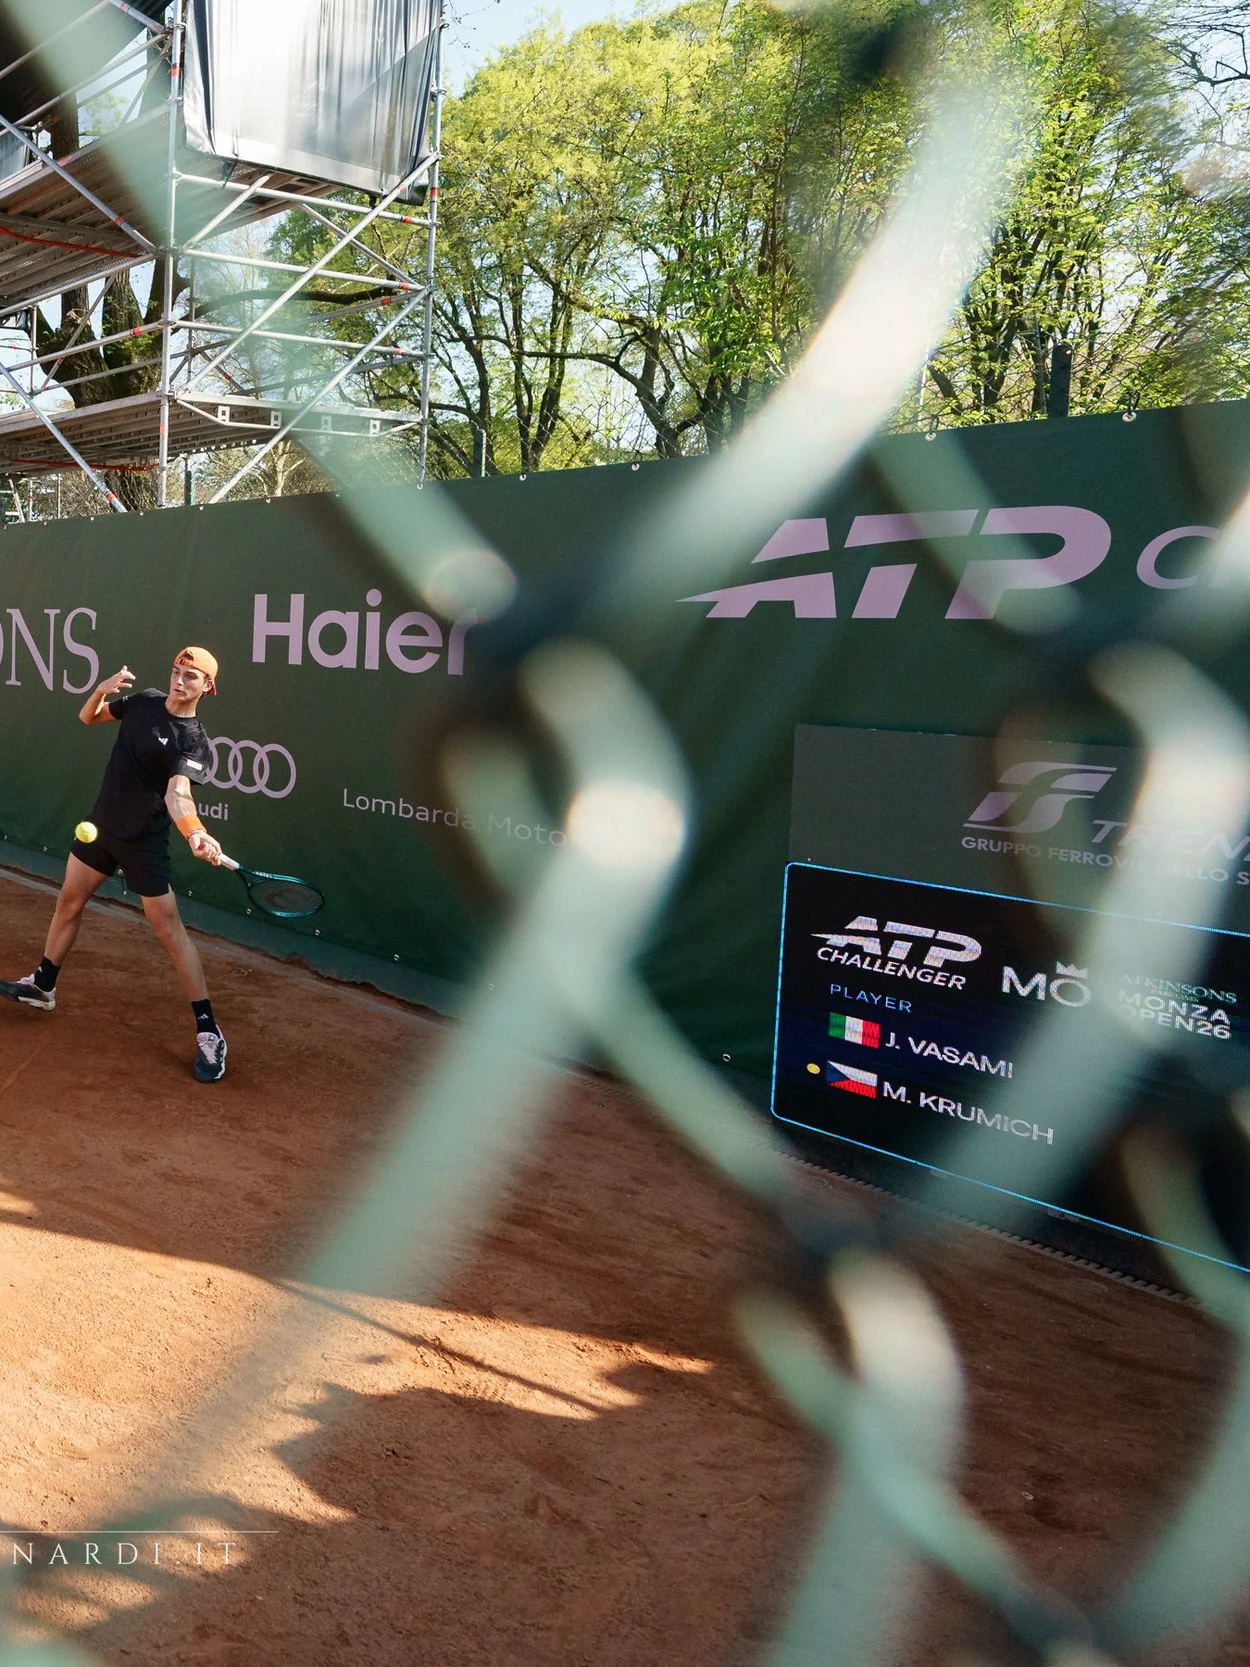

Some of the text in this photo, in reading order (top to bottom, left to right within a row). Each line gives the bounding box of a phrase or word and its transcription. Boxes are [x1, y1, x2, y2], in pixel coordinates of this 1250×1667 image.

[674, 505, 1111, 620] ATP
[252, 588, 478, 676] Haier
[198, 803, 229, 821] udi
[343, 788, 568, 847] Lombarda Moto
[961, 836, 1041, 857] GRUPPO
[811, 915, 982, 968] ATP
[817, 947, 967, 990] CHALLENGER
[1119, 973, 1237, 1004] ATKINSONS
[830, 983, 912, 1013] PLAYER
[1118, 988, 1231, 1025] MONZA
[1117, 1004, 1232, 1040] OPEN26
[885, 1032, 1013, 1079] J. VASAMI
[883, 1081, 1054, 1145] M. KRUMICH
